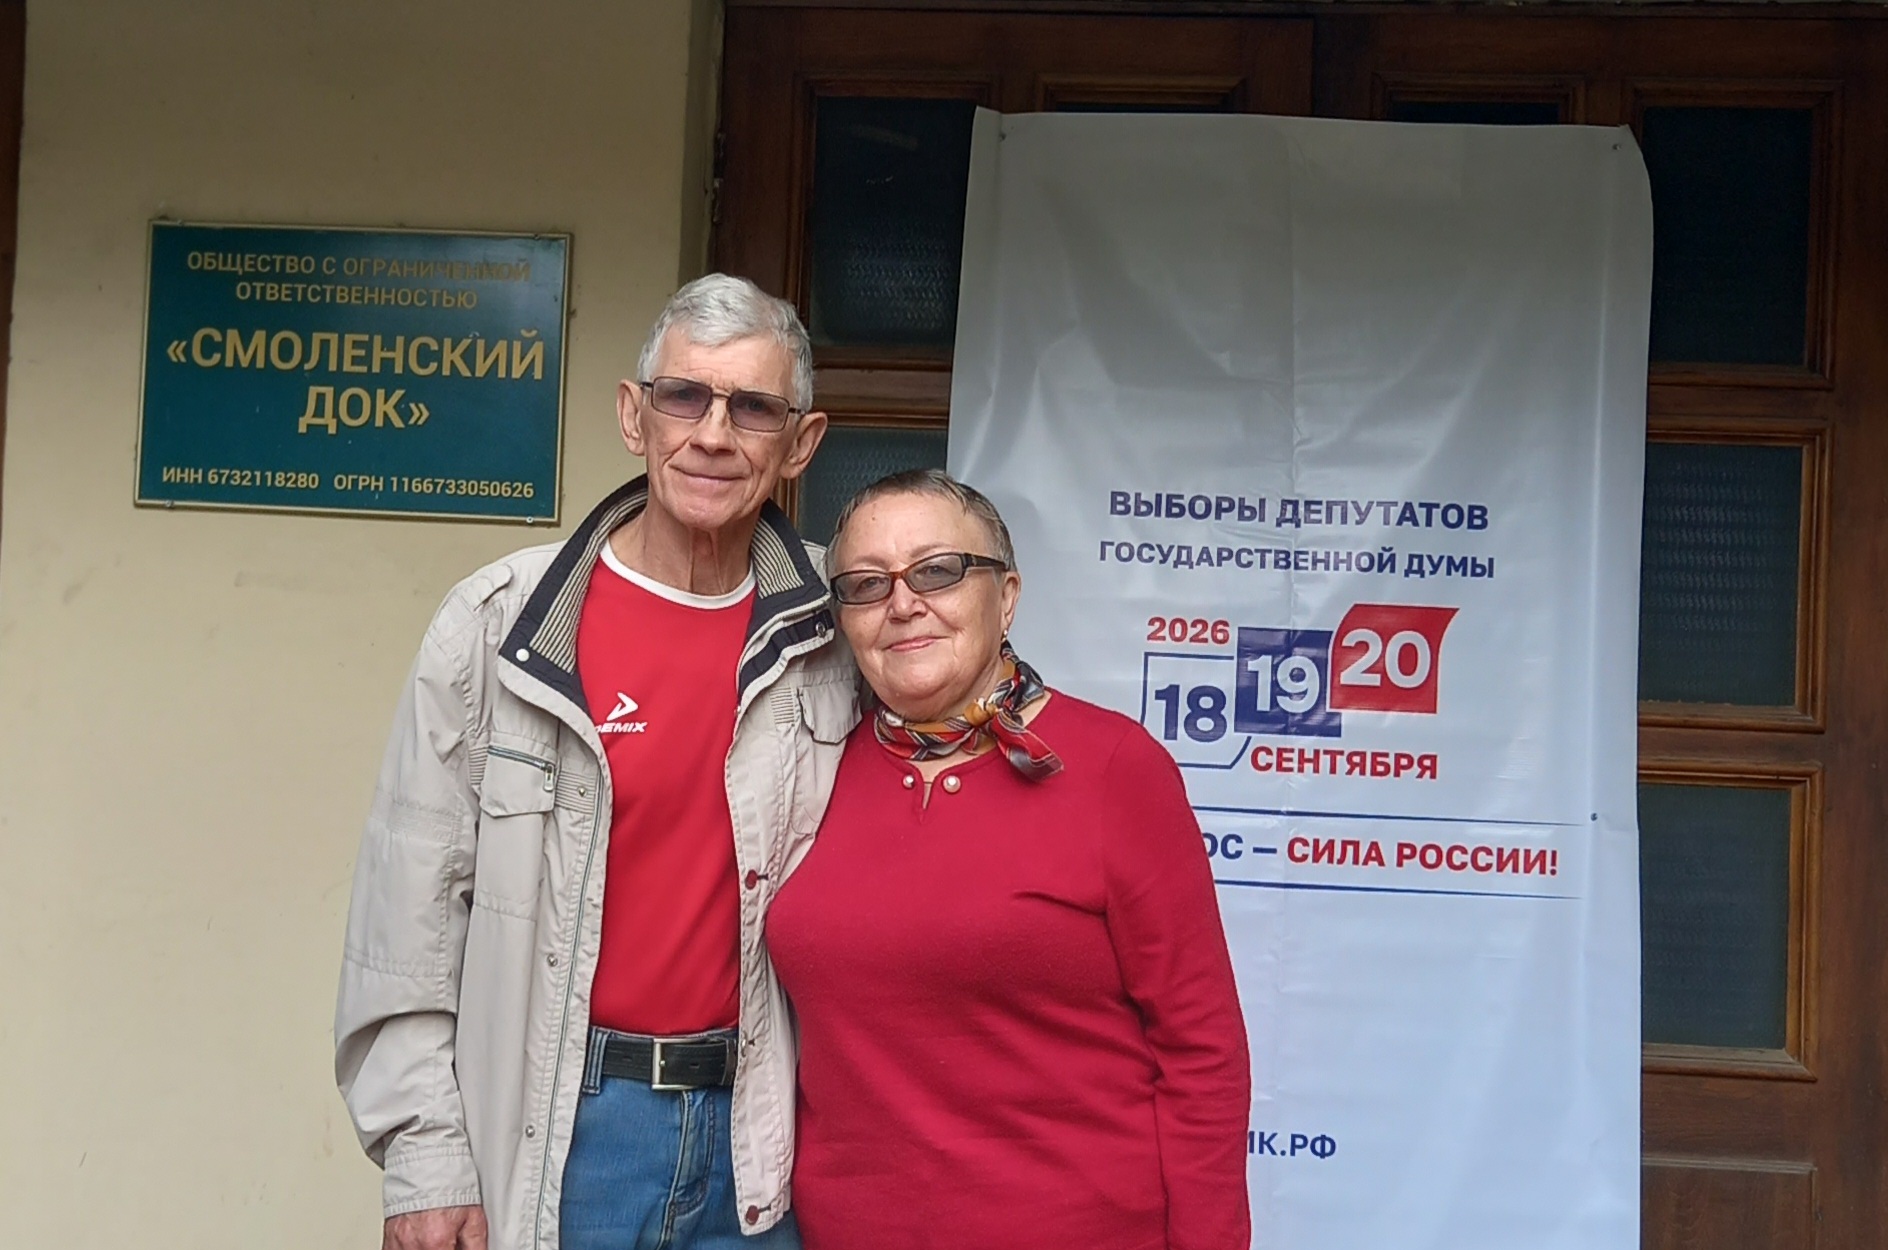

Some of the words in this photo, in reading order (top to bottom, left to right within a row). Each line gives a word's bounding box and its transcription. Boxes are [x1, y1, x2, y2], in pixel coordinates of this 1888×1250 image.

[187, 252, 316, 276] ОБЩЕСТВО
[322, 257, 337, 275] С
[343, 257, 531, 282] ОГРАНИЧЕННОЙ
[236, 282, 478, 309] ОТВЕТСТВЕННОСТЬЮ
[167, 327, 545, 380] «СМОЛЕНСКИЙ
[298, 385, 430, 434] ДОК»
[162, 466, 203, 484] ИНН
[207, 468, 320, 489] 6732118280
[333, 474, 384, 492] ОГРН
[390, 476, 534, 498] 1166733050626
[1109, 490, 1266, 523] ВЫБОРЫ
[1276, 498, 1489, 530] ДЕПУТАТОВ
[1099, 541, 1397, 574] ГОСУДАРСТВЕННОЙ
[1403, 551, 1495, 579] ДУМЫ
[1146, 616, 1230, 645] 2026
[1154, 683, 1228, 743] 18
[1247, 655, 1321, 714] 19
[1339, 628, 1432, 688] 20
[1250, 746, 1438, 780] СЕНТЯБРЯ
[1286, 836, 1386, 868] СИЛА
[1396, 841, 1558, 877] РОССИИ!
[1248, 1130, 1337, 1159] К.РФ
